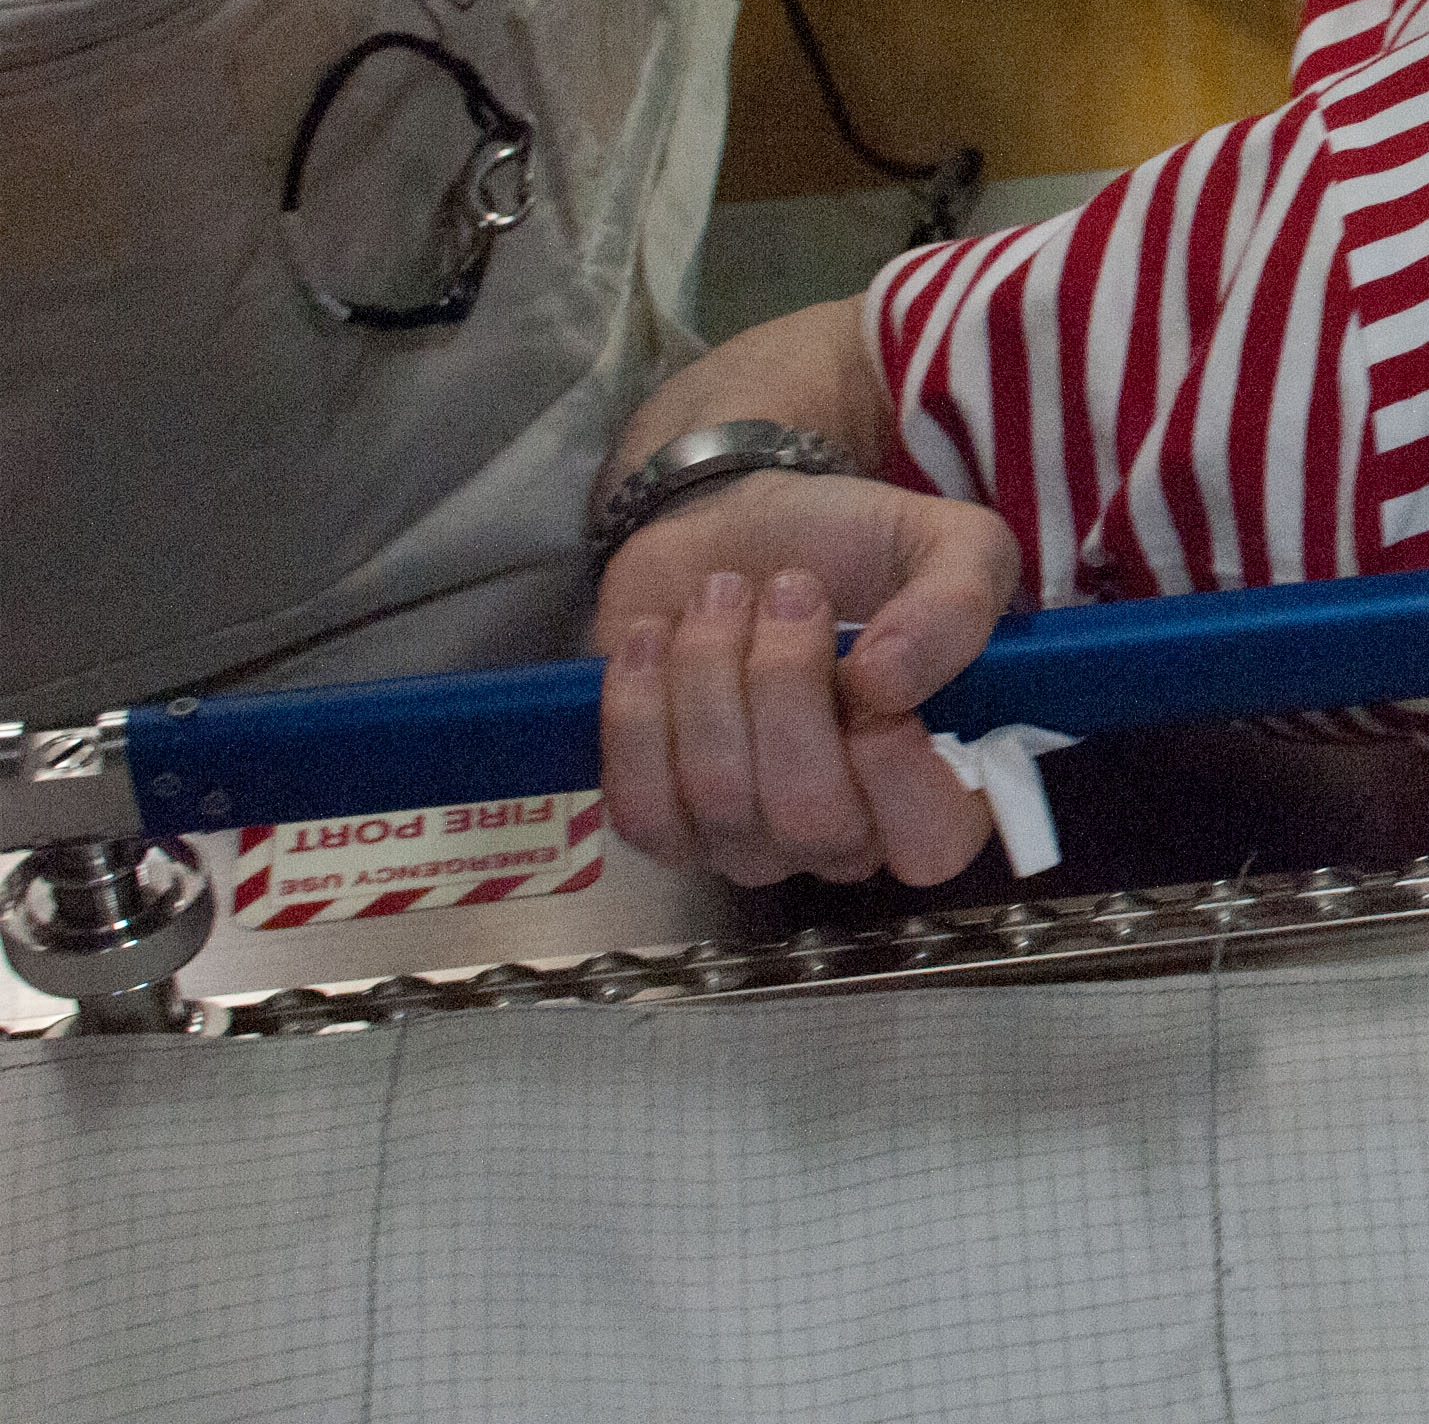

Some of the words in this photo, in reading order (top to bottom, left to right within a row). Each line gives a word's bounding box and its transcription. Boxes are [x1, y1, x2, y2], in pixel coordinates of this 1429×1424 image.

[286, 814, 426, 855] PORT
[443, 797, 554, 835] FIRE
[279, 873, 345, 897] USE
[354, 846, 560, 886] EMERGENCY
